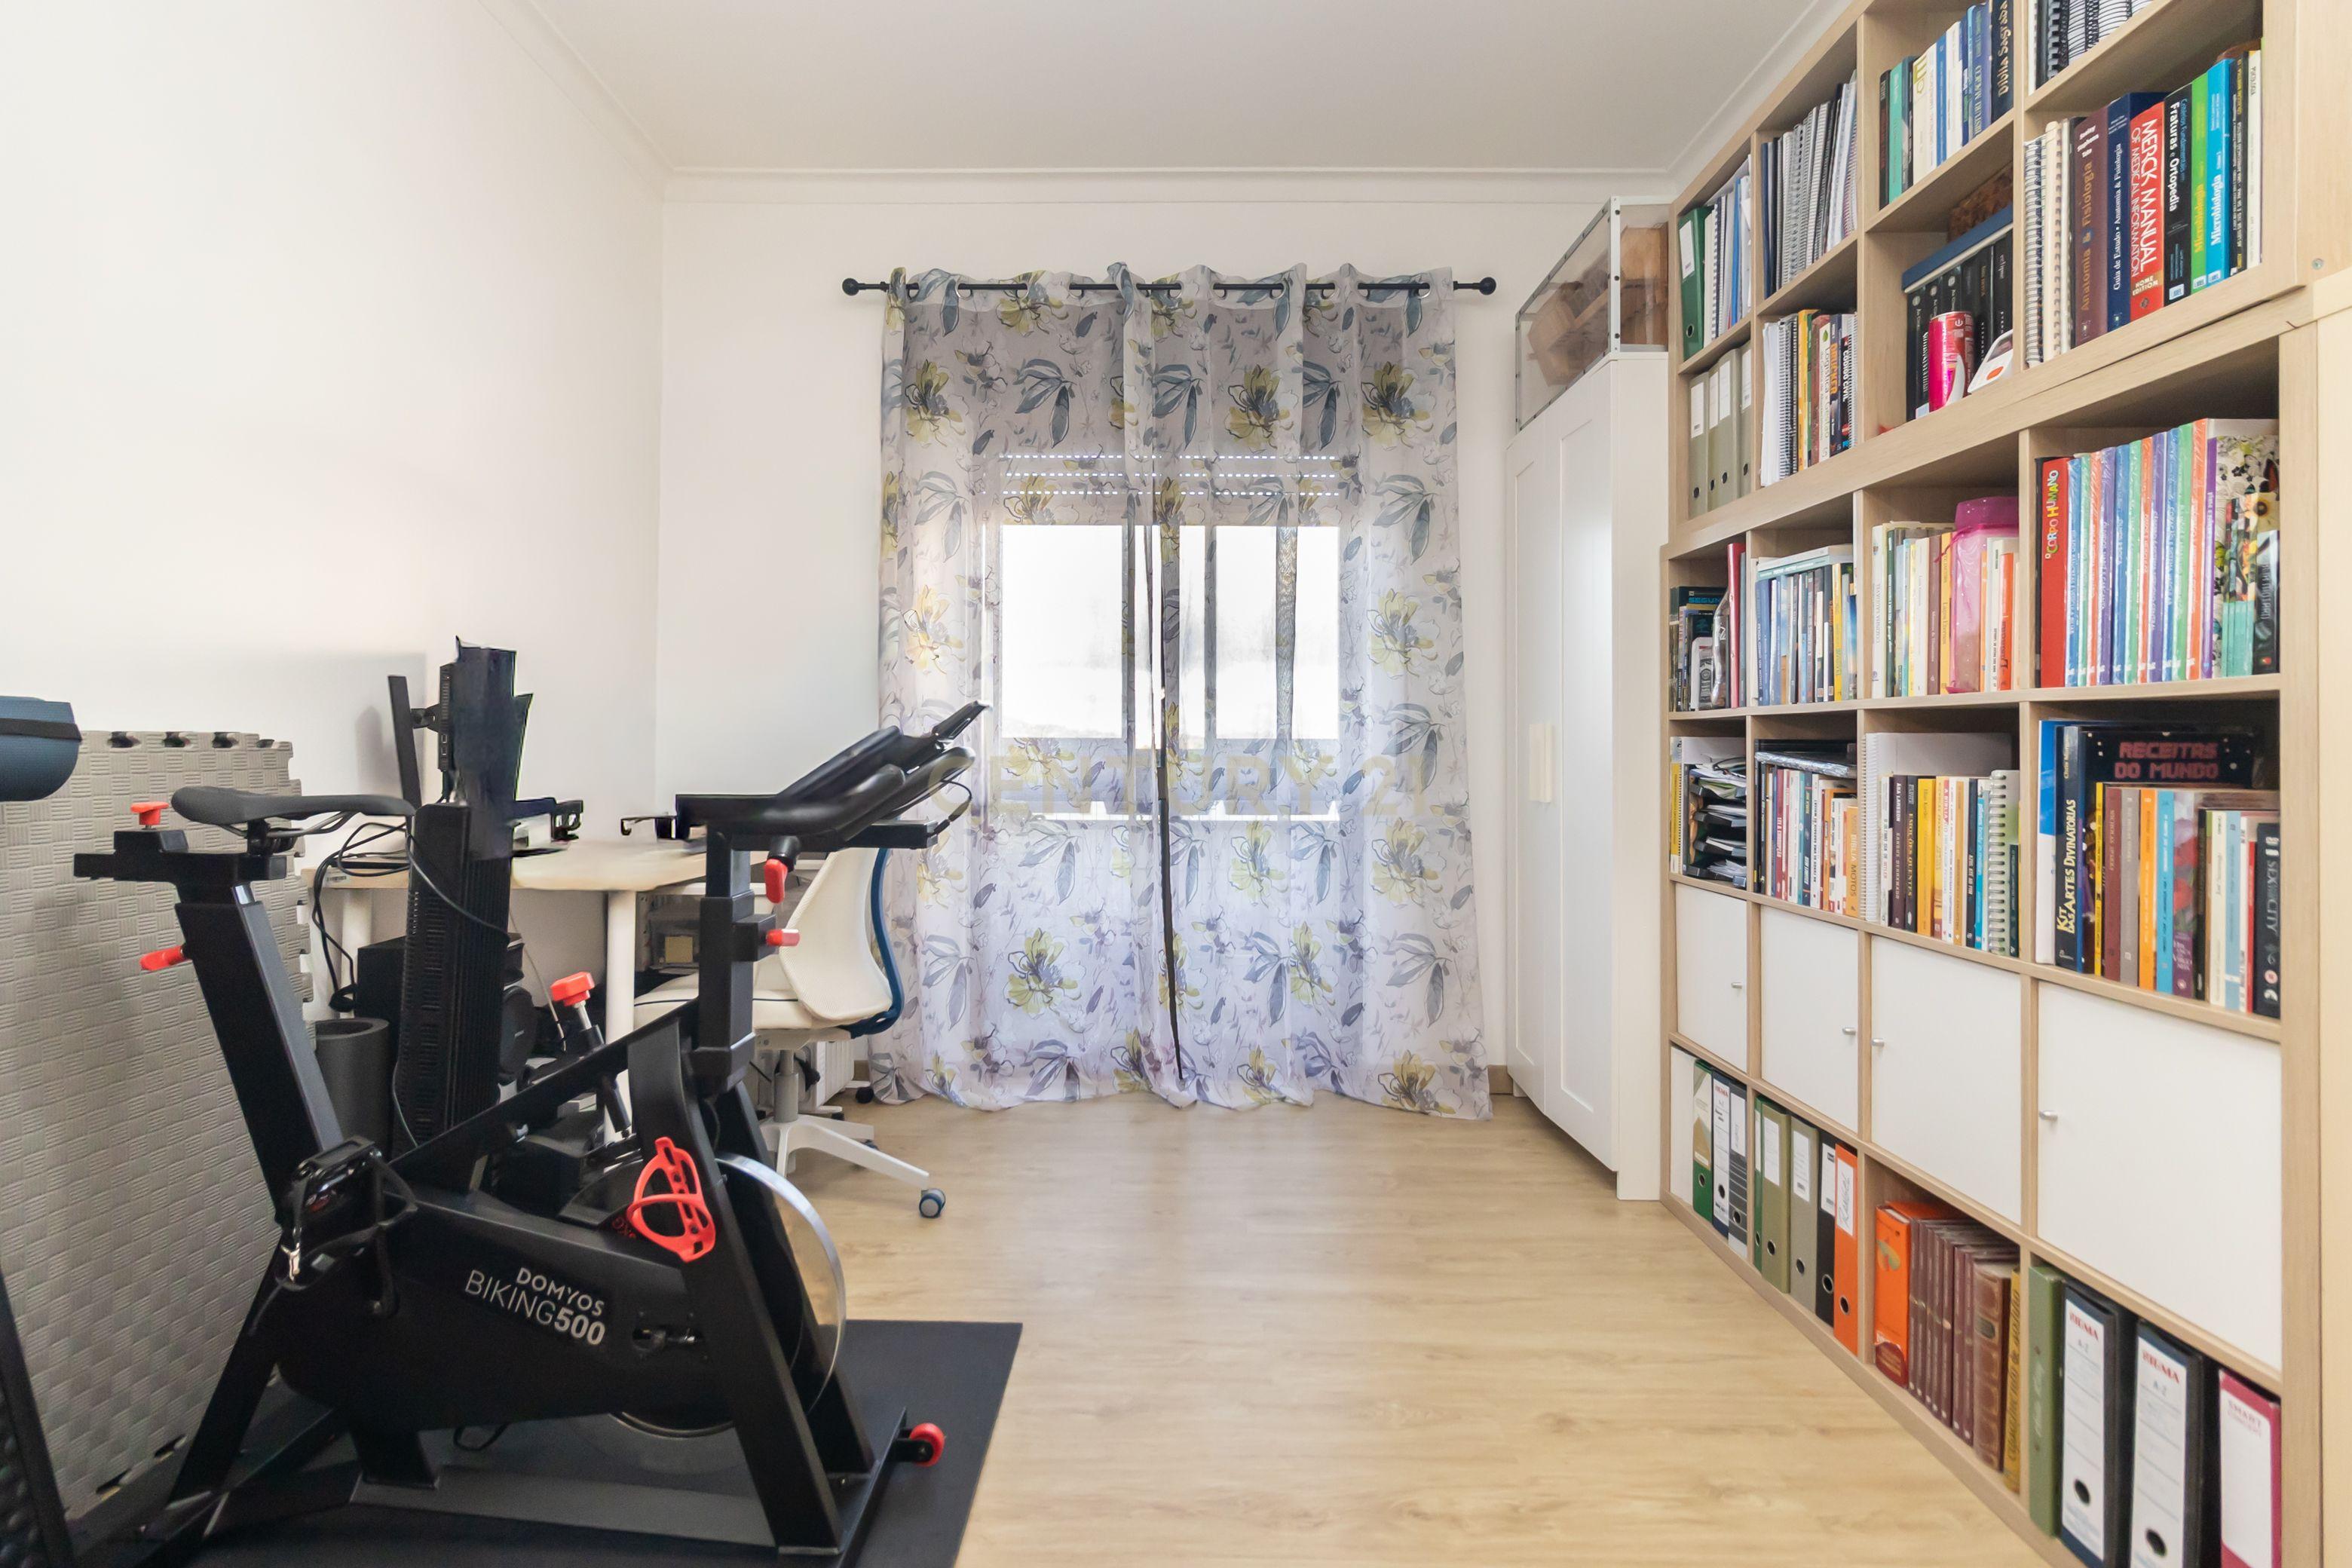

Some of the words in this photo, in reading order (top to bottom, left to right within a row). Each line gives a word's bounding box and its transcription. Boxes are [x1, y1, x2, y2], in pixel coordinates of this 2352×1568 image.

[2131, 127, 2141, 143] OF
[2170, 102, 2179, 150] Fraturas
[2114, 143, 2123, 180] Fisiologia
[2131, 147, 2141, 197] MEDICAL
[2140, 118, 2158, 186] MERCK
[2081, 161, 2095, 226] Fisiologia
[2114, 180, 2121, 188] &
[2167, 158, 2179, 212] Ortopedia
[2140, 188, 2158, 272] MANUAL
[2194, 183, 2205, 253] Microbiologia
[2210, 174, 2223, 246] Microbiologia
[2131, 198, 2141, 277] INFORMATION
[2081, 248, 2091, 311] Anatomia
[2113, 260, 2121, 269] de
[2046, 470, 2059, 518] HUMANO
[2047, 518, 2059, 553] CORPO
[2114, 761, 2141, 779] DO
[2149, 761, 2219, 779] MUNDO
[2119, 741, 2219, 759] RECEITAS
[2063, 868, 2075, 914] ARTES
[2056, 906, 2068, 932] KIT
[2065, 911, 2075, 934] DAS
[2266, 898, 2279, 936] CITY
[516, 1267, 605, 1317] DOMYOS
